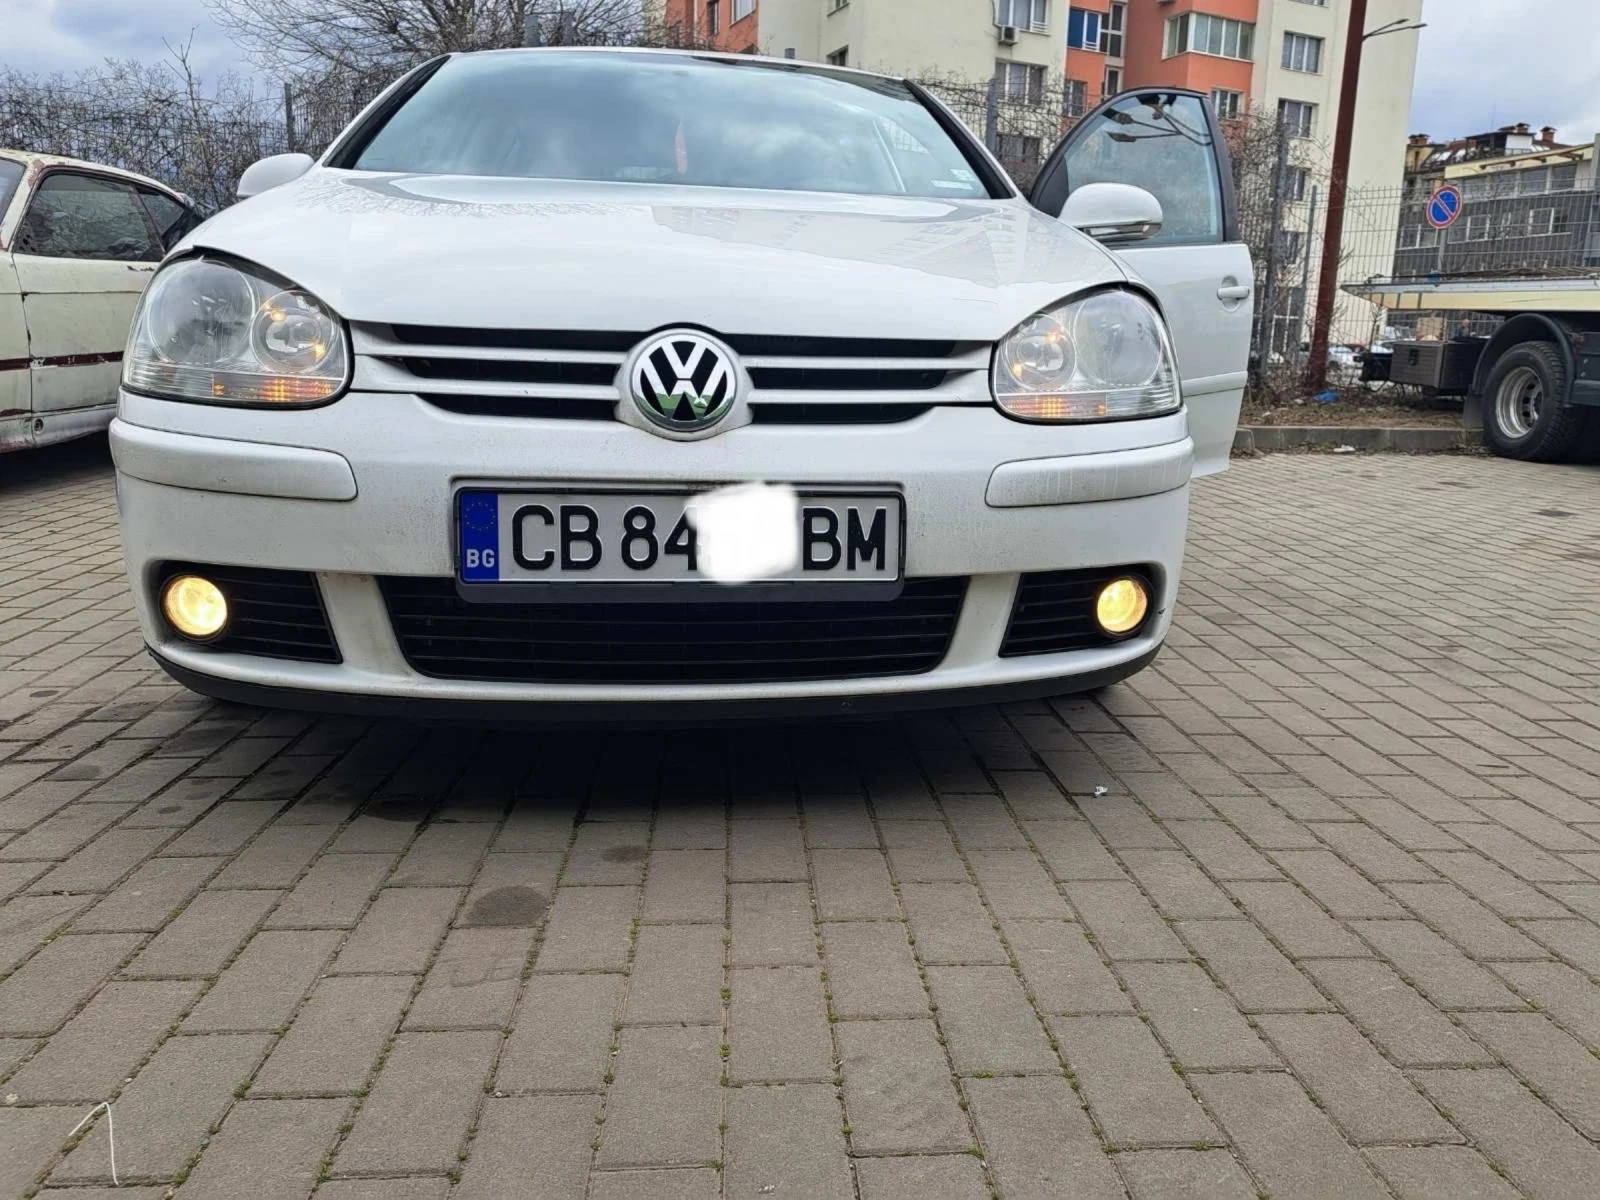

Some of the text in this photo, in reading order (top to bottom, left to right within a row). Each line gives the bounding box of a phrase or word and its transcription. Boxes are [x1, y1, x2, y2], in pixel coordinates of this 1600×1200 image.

[634, 336, 733, 425] VW
[466, 549, 496, 568] BG
[512, 504, 603, 571] CB
[803, 506, 887, 571] BM
